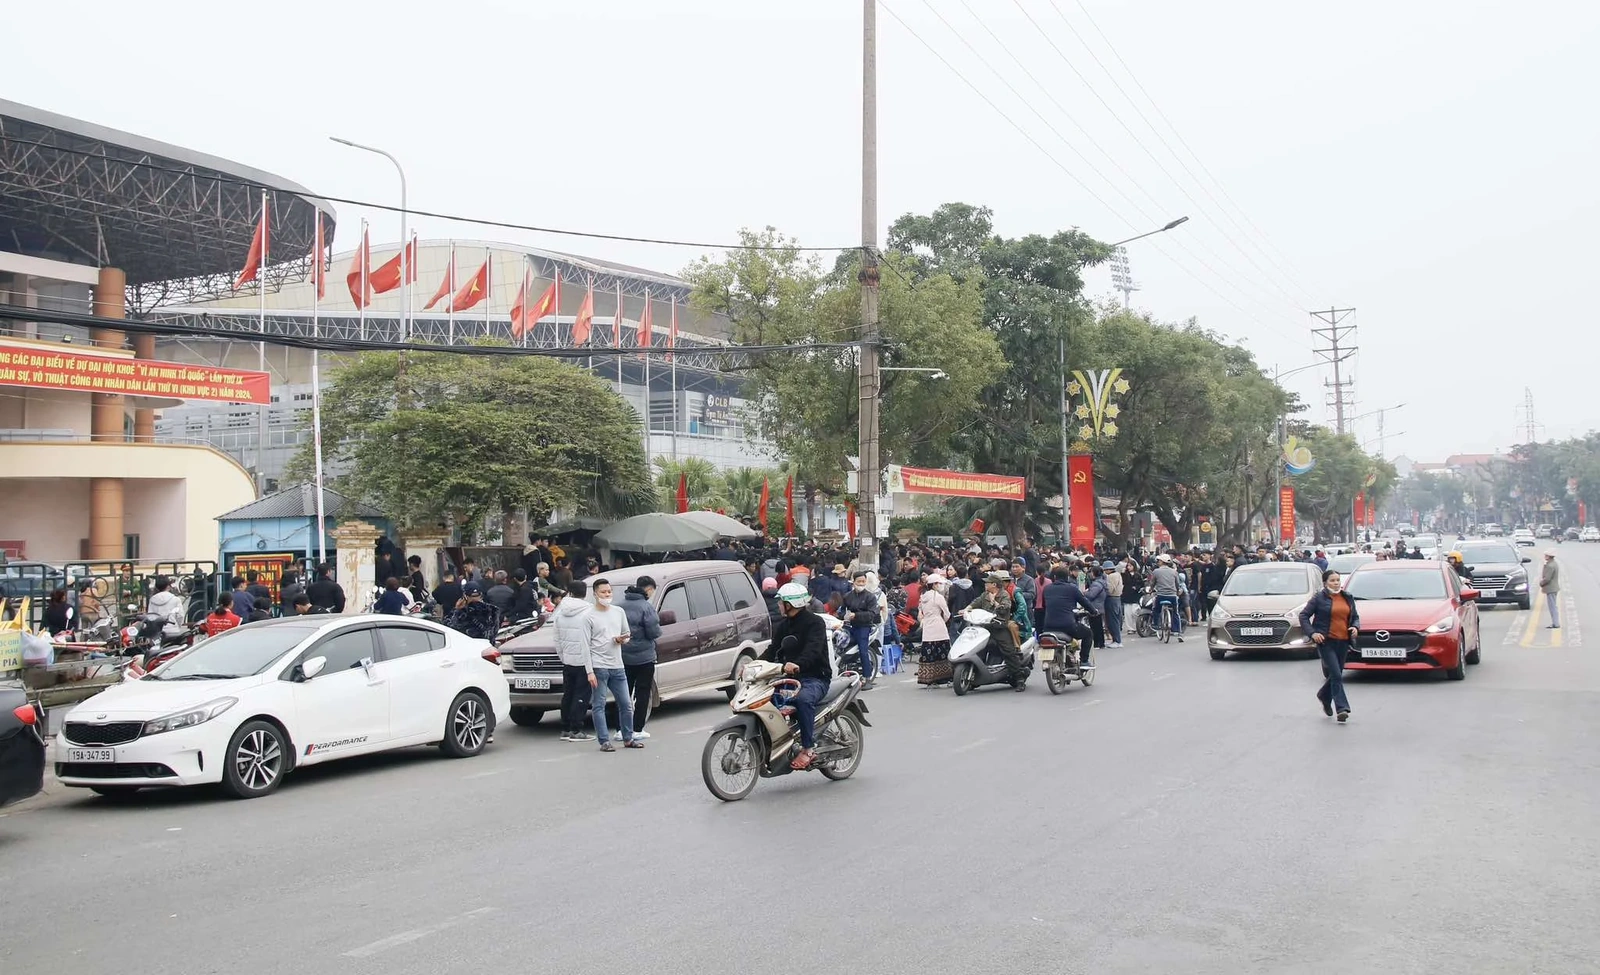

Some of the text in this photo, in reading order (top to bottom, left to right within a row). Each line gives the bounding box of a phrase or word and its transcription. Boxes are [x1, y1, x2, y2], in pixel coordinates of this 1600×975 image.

[12, 351, 29, 365] CÁC
[30, 355, 44, 369] ĐẠI
[45, 353, 64, 369] BIỂU
[65, 356, 76, 370] VỀ
[76, 360, 88, 373] DỰ
[88, 362, 101, 374] ĐẠI
[102, 361, 115, 374] HỘI
[148, 367, 159, 378] AN
[159, 368, 177, 379] NINH
[178, 367, 187, 380] TỔ
[209, 371, 222, 383] LẦN
[223, 373, 235, 384] THỨ
[235, 375, 243, 385] IX
[17, 370, 31, 384] SỰ,
[32, 371, 43, 383] VÕ
[45, 372, 69, 386] THUẬT
[70, 374, 91, 387] CÔNG
[92, 378, 103, 388] AN
[104, 378, 125, 390] NHÂN
[126, 379, 141, 391] DÂN
[142, 380, 156, 392] LẦN
[158, 380, 171, 393] THỨ
[171, 383, 179, 393] VI
[180, 384, 196, 395] (KHU
[197, 385, 210, 397] VỰC
[210, 387, 218, 397] 2)
[219, 386, 235, 398] NĂM
[313, 735, 369, 750] PERFORMANCE
[72, 750, 111, 760] 19A-347.99
